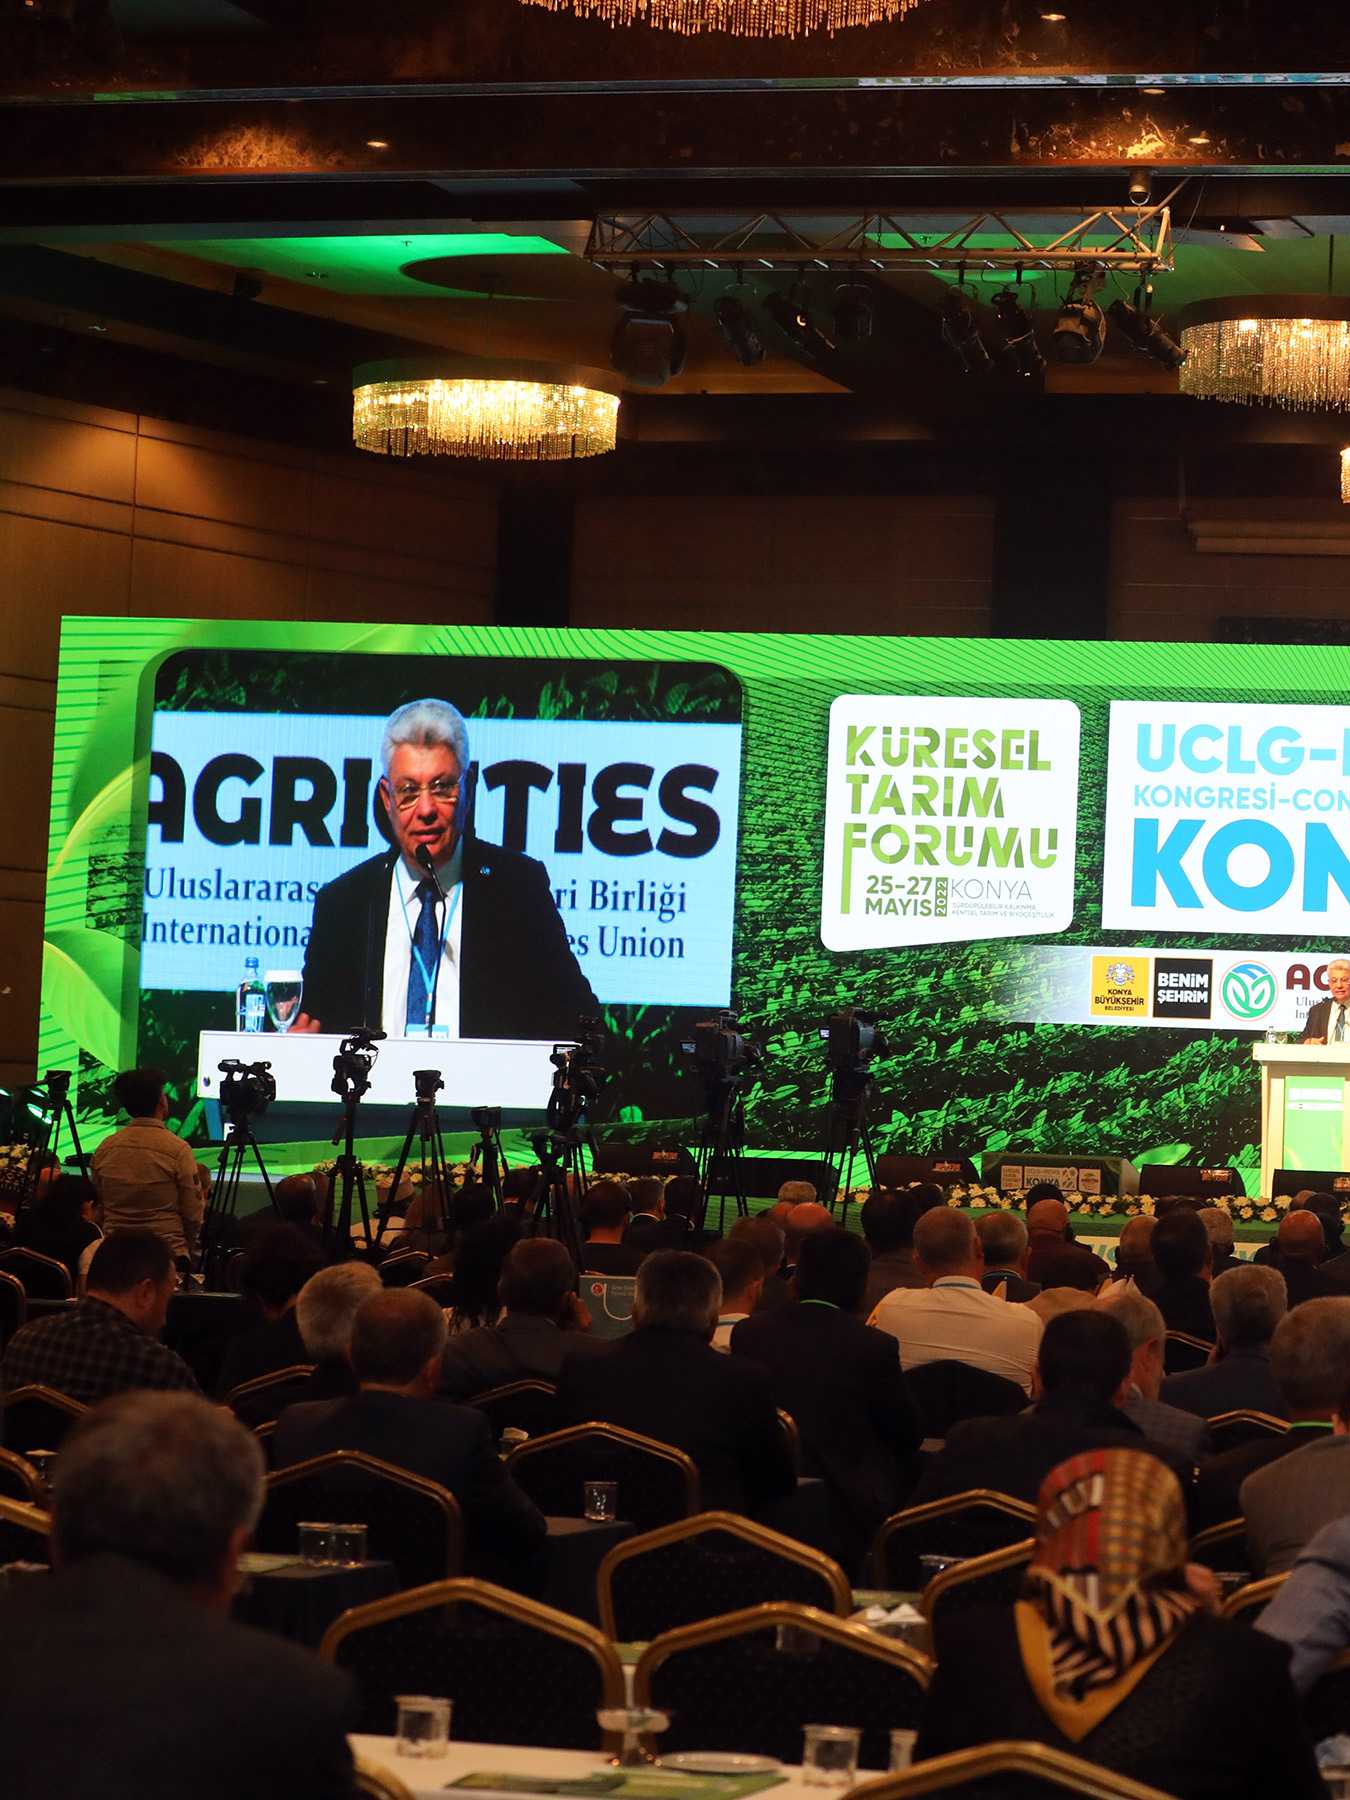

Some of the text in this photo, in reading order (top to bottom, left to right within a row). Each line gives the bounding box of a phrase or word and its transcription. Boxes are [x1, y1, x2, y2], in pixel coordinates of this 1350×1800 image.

[846, 725, 1051, 771] KÜRESEL
[147, 750, 721, 859] GRITIES
[846, 773, 1005, 818] TARIM
[841, 822, 1058, 914] FORUMU
[866, 875, 932, 895] 25-27
[589, 878, 687, 923] Birliği
[865, 898, 932, 916] MAYIS
[935, 879, 948, 916] 2022
[951, 878, 1032, 900] KONYA
[142, 911, 312, 948] Internationa
[598, 925, 685, 958] Union
[1094, 996, 1144, 1006] BÜYÜKŞEHİR
[1107, 988, 1132, 996] KONYA
